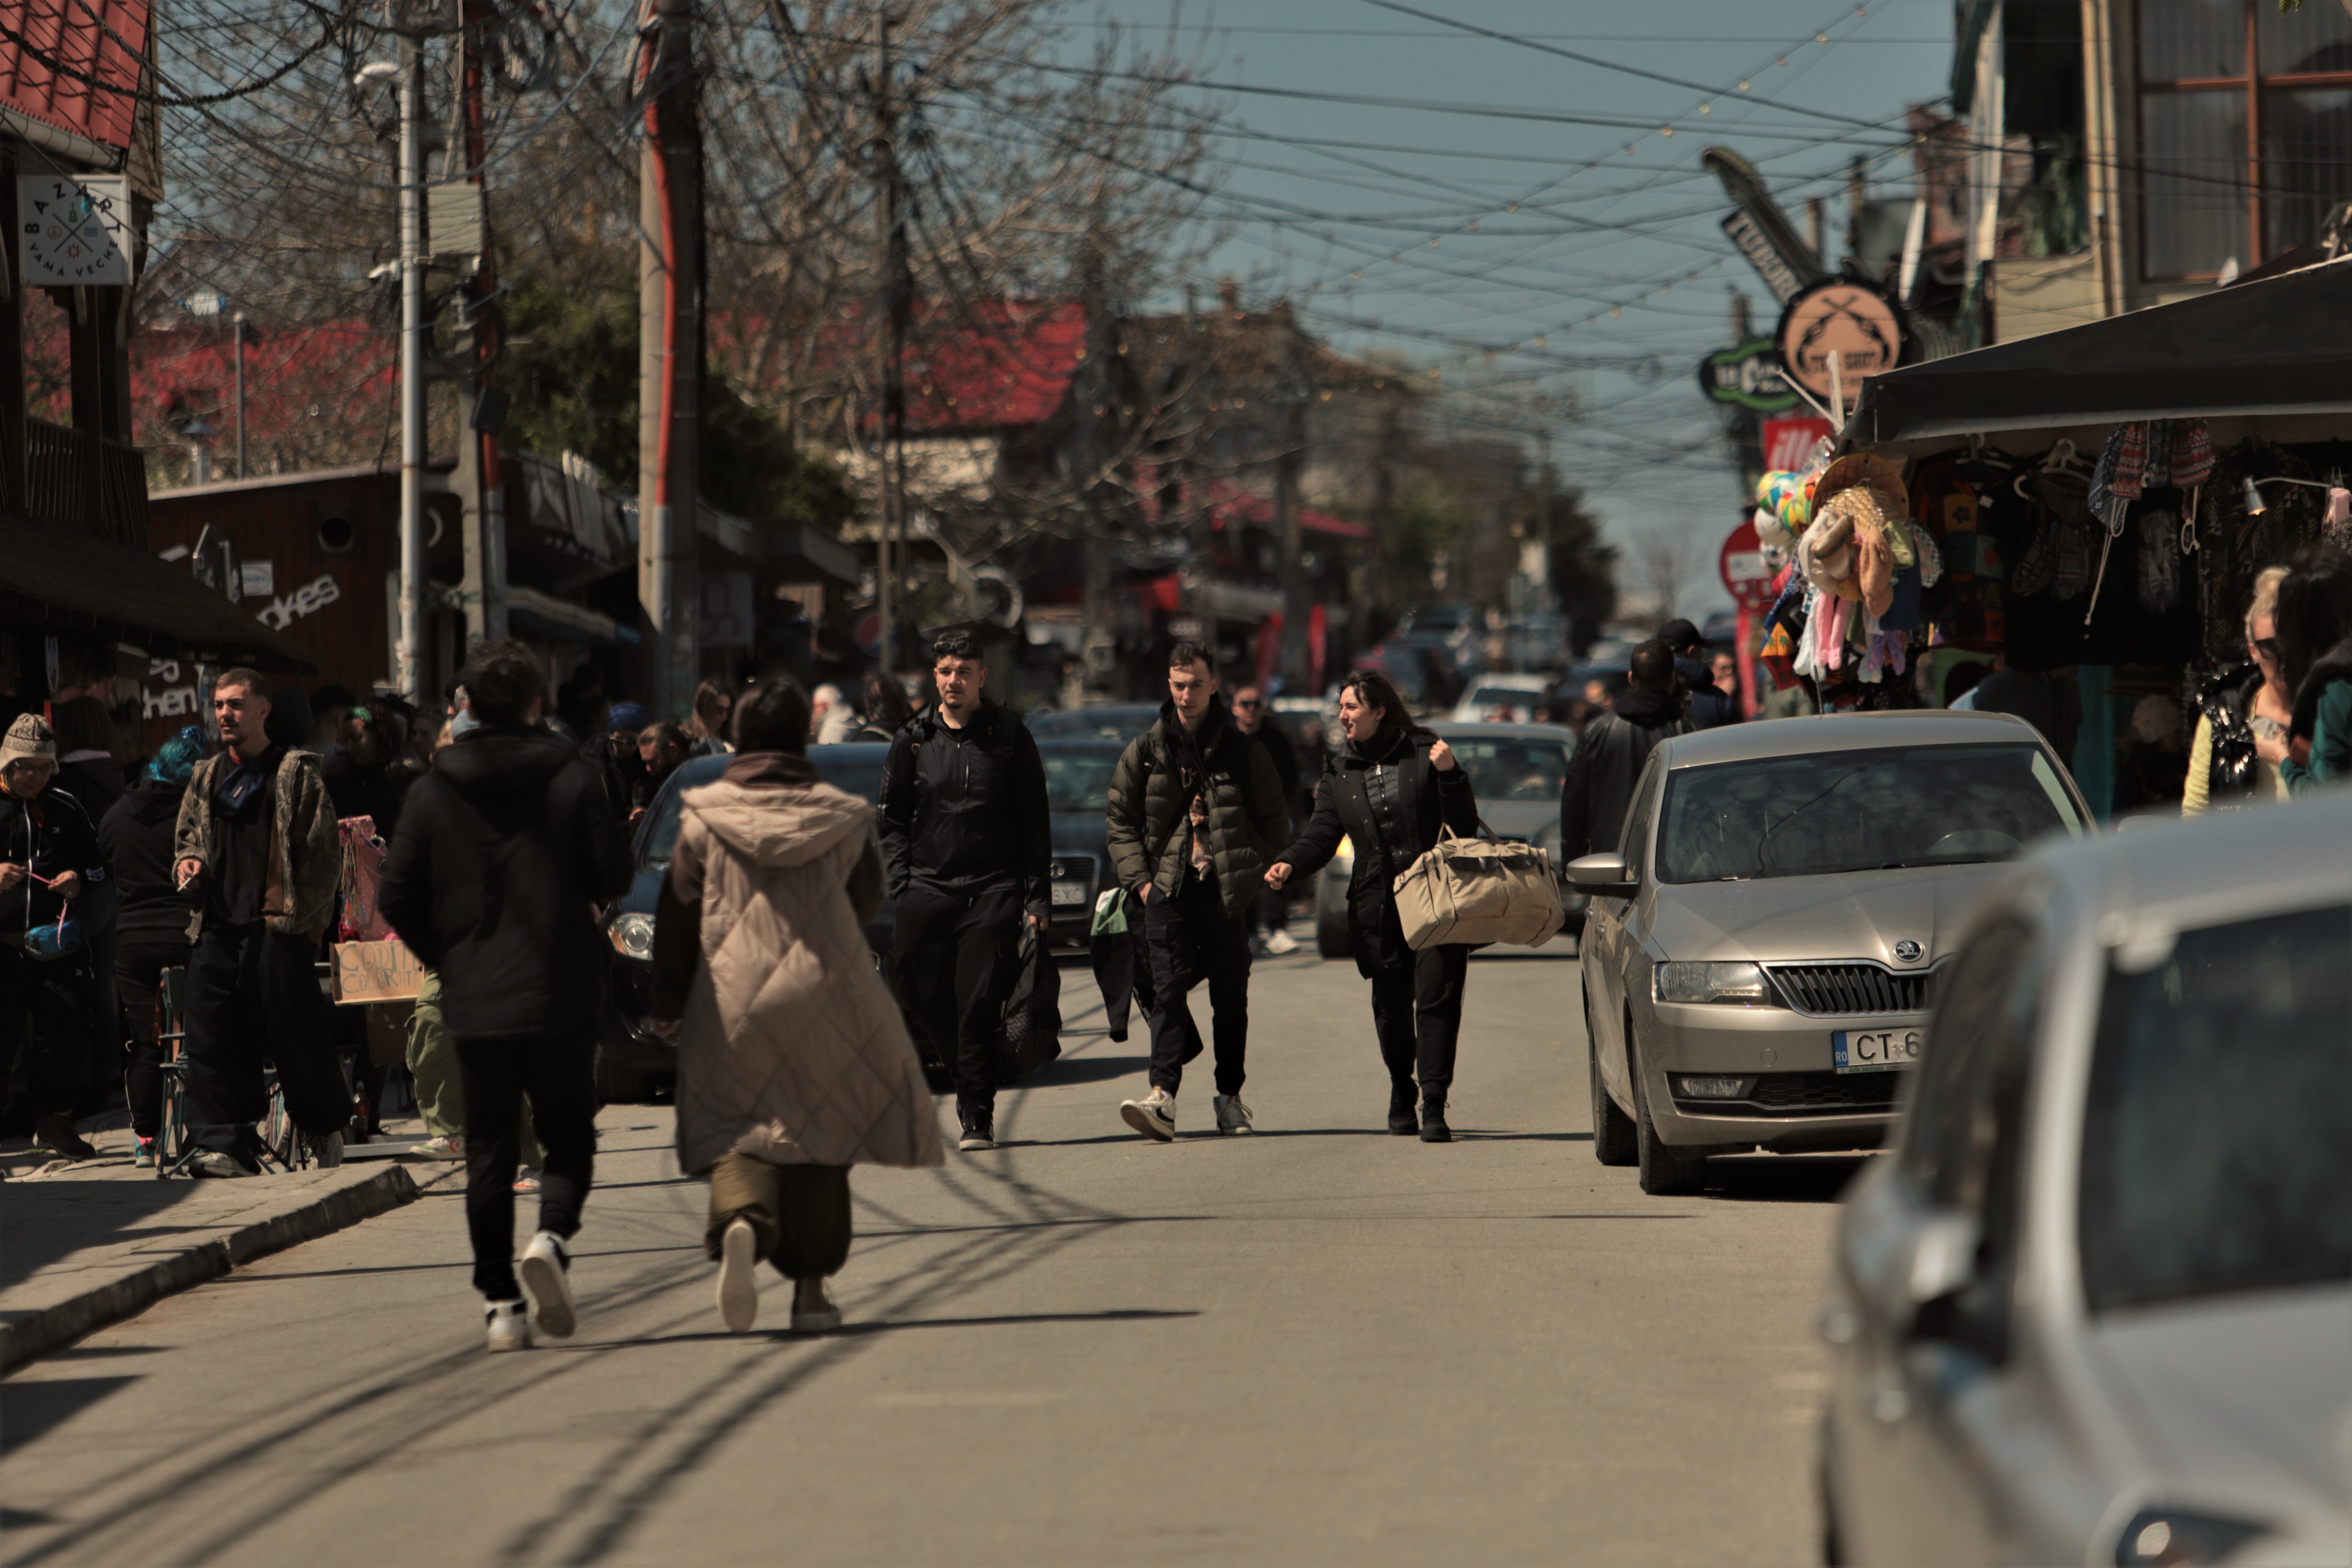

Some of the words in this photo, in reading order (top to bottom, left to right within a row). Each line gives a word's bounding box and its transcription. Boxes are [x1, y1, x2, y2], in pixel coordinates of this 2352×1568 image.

[30, 242, 64, 277] VAMA
[75, 241, 118, 278] VECHE
[1767, 427, 1815, 472] ill
[1835, 1051, 1847, 1062] RO
[1857, 1033, 1892, 1060] CT
[1905, 1031, 1923, 1058] 6
